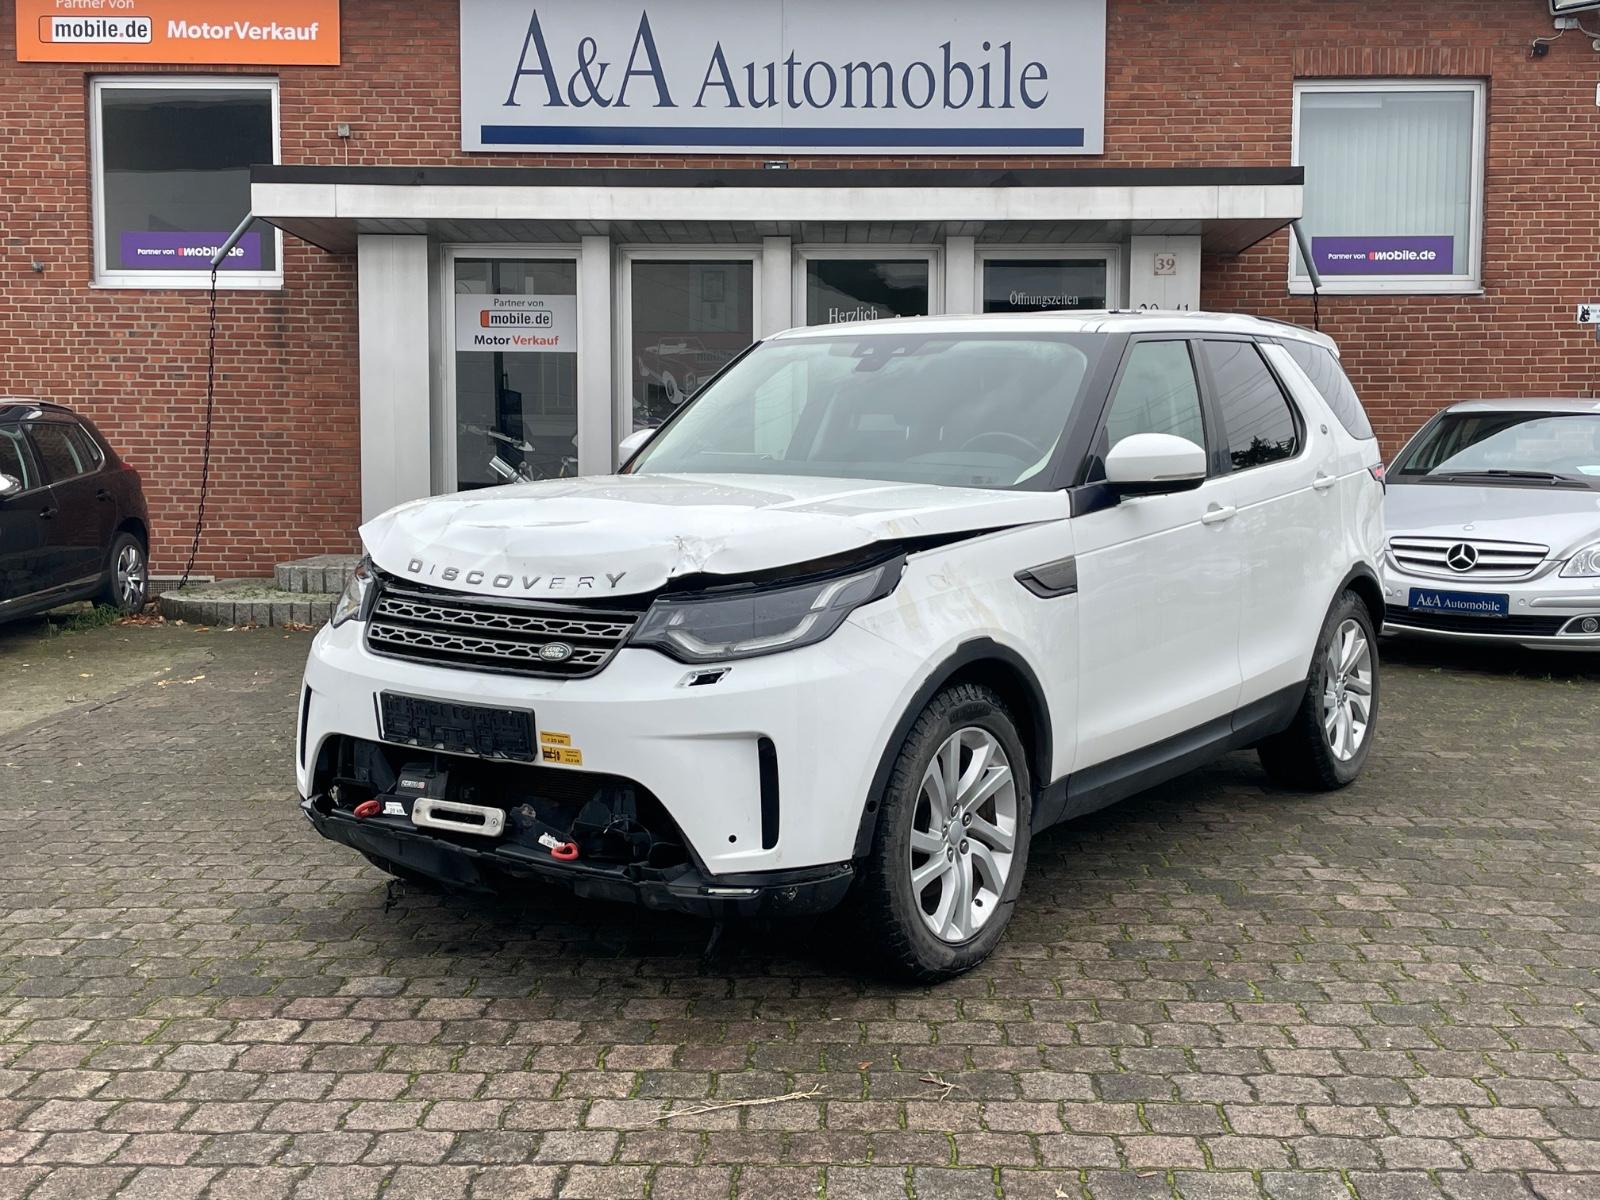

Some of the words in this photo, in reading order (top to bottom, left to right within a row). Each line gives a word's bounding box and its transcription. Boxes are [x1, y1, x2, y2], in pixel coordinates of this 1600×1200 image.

[56, 0, 104, 9] Partner
[108, 0, 135, 9] von
[54, 20, 148, 38] mobile.de
[502, 9, 678, 108] A&A
[692, 40, 1049, 110] Automobile
[137, 248, 162, 256] Partner
[1375, 250, 1436, 261] mobile.de
[1156, 258, 1175, 271] 39
[493, 298, 526, 307] Partner
[527, 299, 544, 307] von
[1009, 290, 1079, 308] Öffnungszeiten
[490, 313, 550, 325] mobile.de
[828, 305, 878, 323] Herzlich
[407, 557, 627, 591] DISCOVERY
[1416, 592, 1441, 607] A&A
[1443, 598, 1500, 611] Automobile
